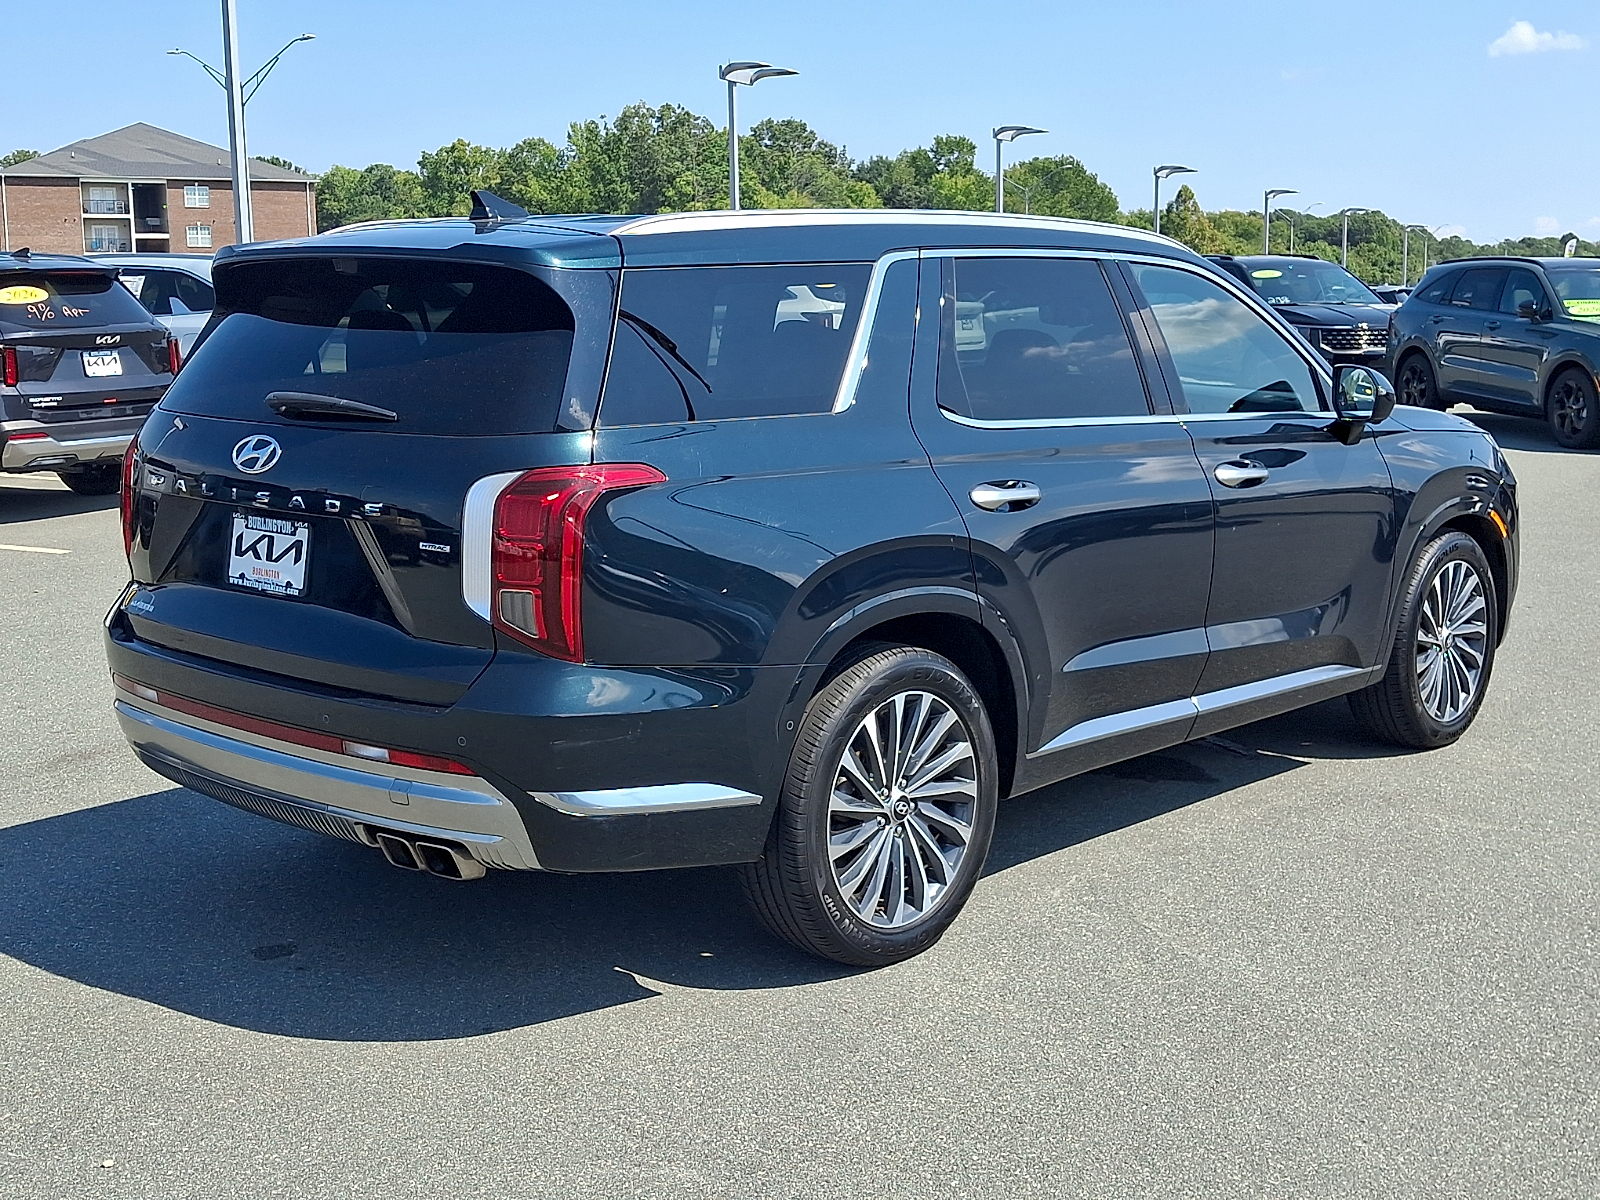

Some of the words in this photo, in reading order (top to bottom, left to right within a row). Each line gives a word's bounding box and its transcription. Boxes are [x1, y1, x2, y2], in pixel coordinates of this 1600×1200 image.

[6, 289, 38, 301] 2026
[87, 357, 118, 367] KIA
[149, 475, 384, 517] PALISADE
[247, 515, 292, 534] BURLINGTON
[234, 530, 304, 566] KIA
[252, 566, 280, 580] BURLINGTON
